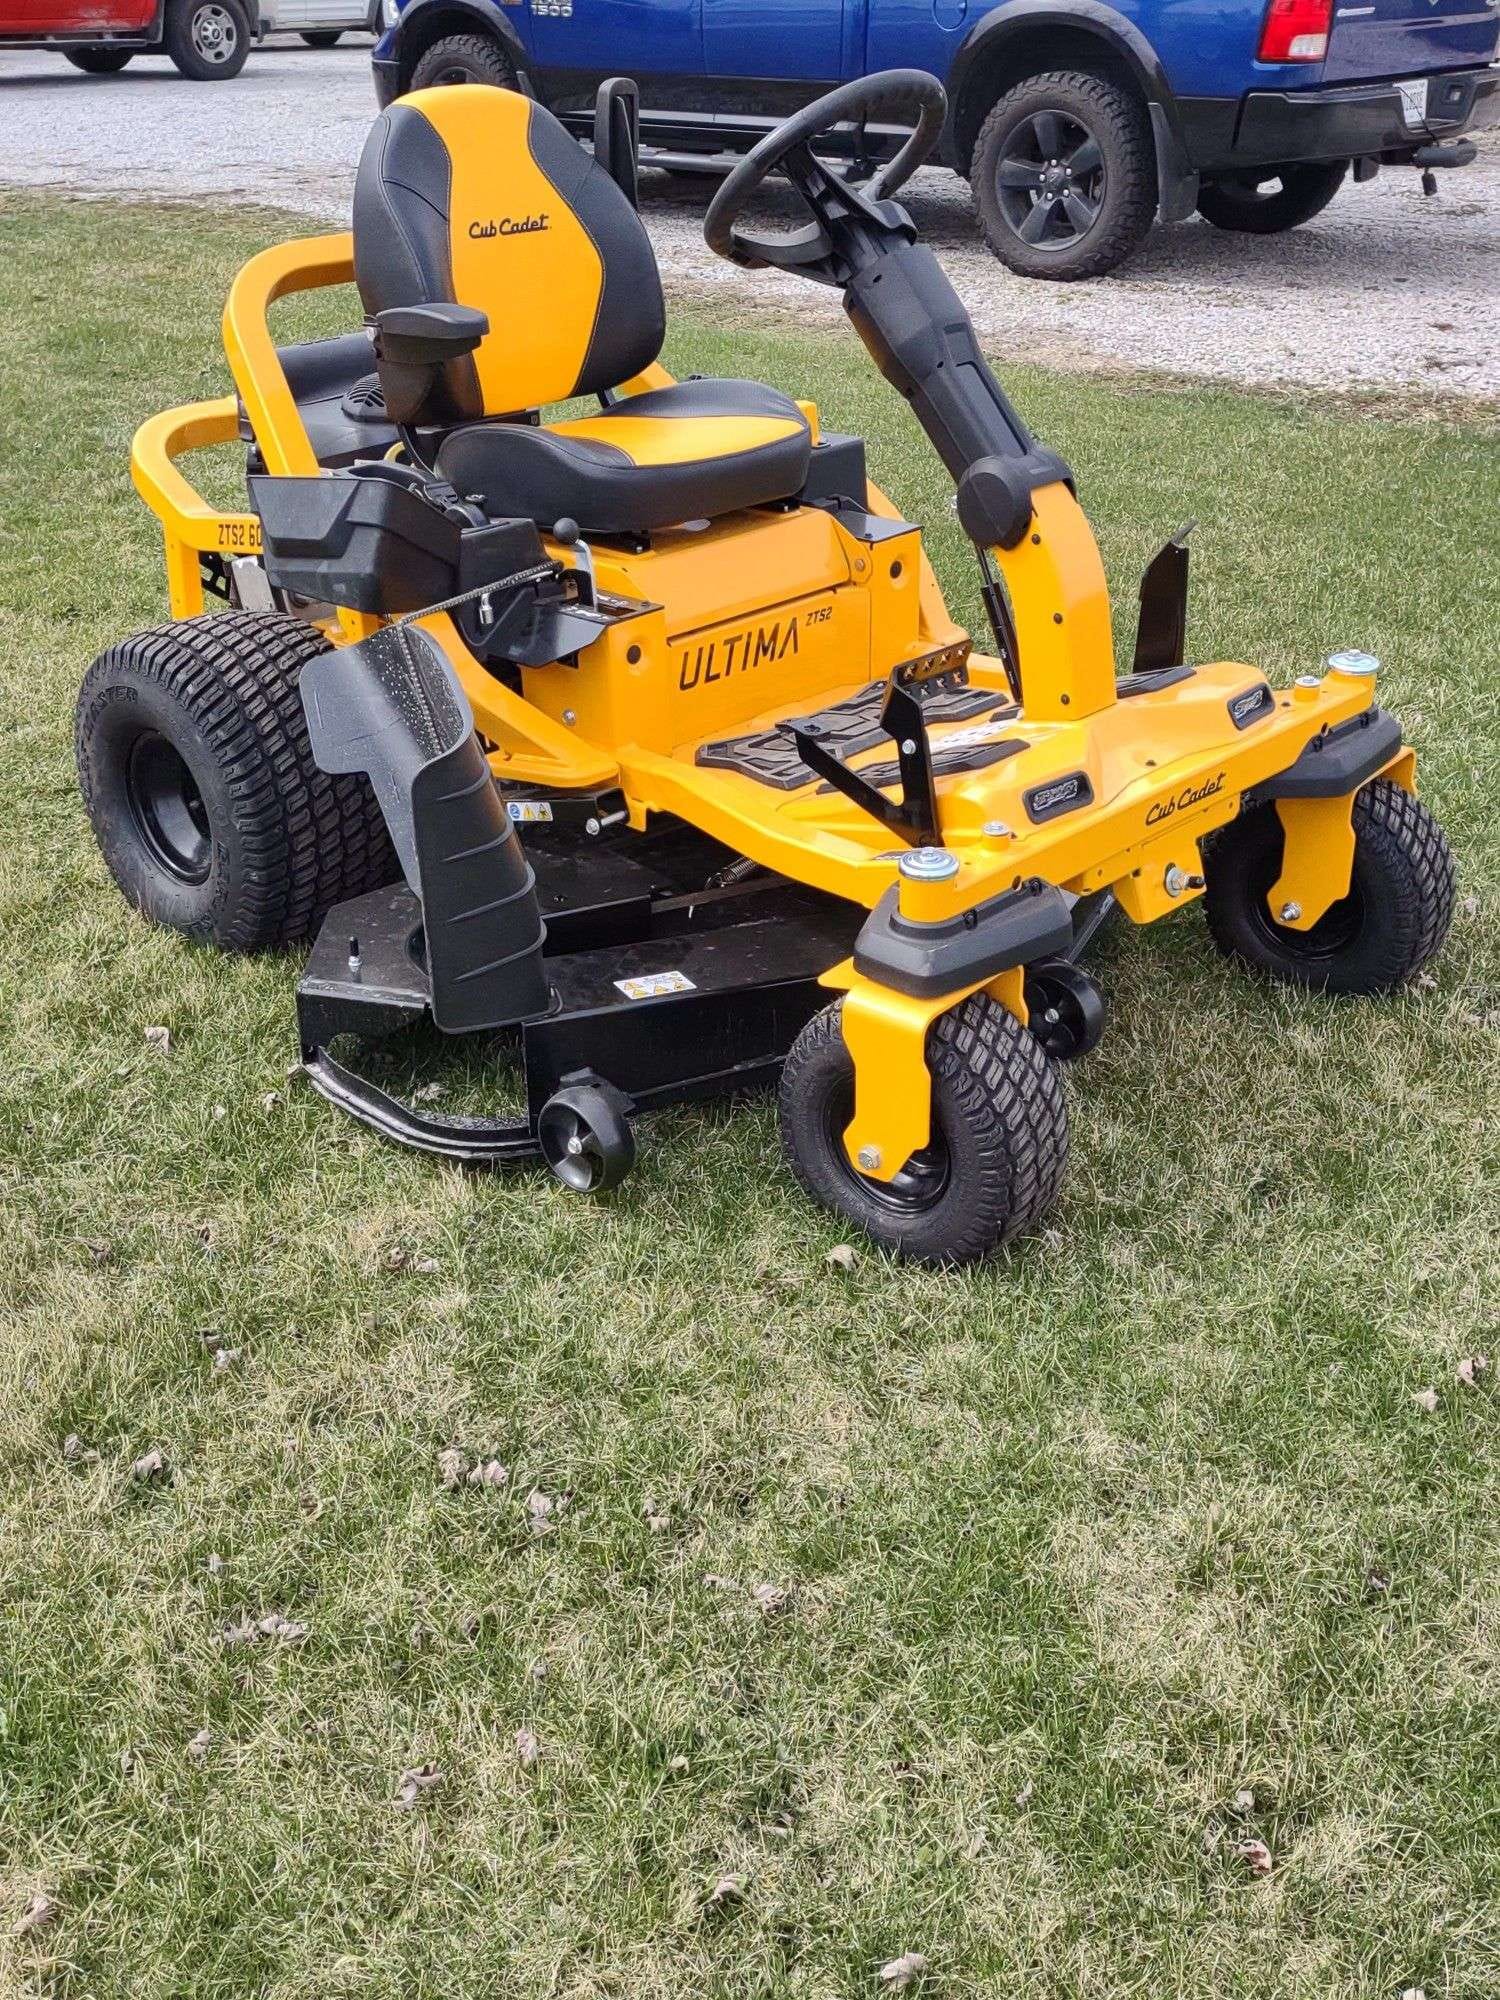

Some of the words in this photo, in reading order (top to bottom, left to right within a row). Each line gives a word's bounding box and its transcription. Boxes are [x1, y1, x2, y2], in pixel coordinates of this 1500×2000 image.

[531, 5, 573, 17] 1500
[468, 220, 498, 239] Cub
[499, 213, 550, 236] Cadet
[218, 523, 245, 546] ZTS2
[679, 616, 799, 691] ULTIMA
[805, 606, 833, 627] ZTS2
[1145, 795, 1176, 826] Cub
[1177, 771, 1227, 811] Cadet
